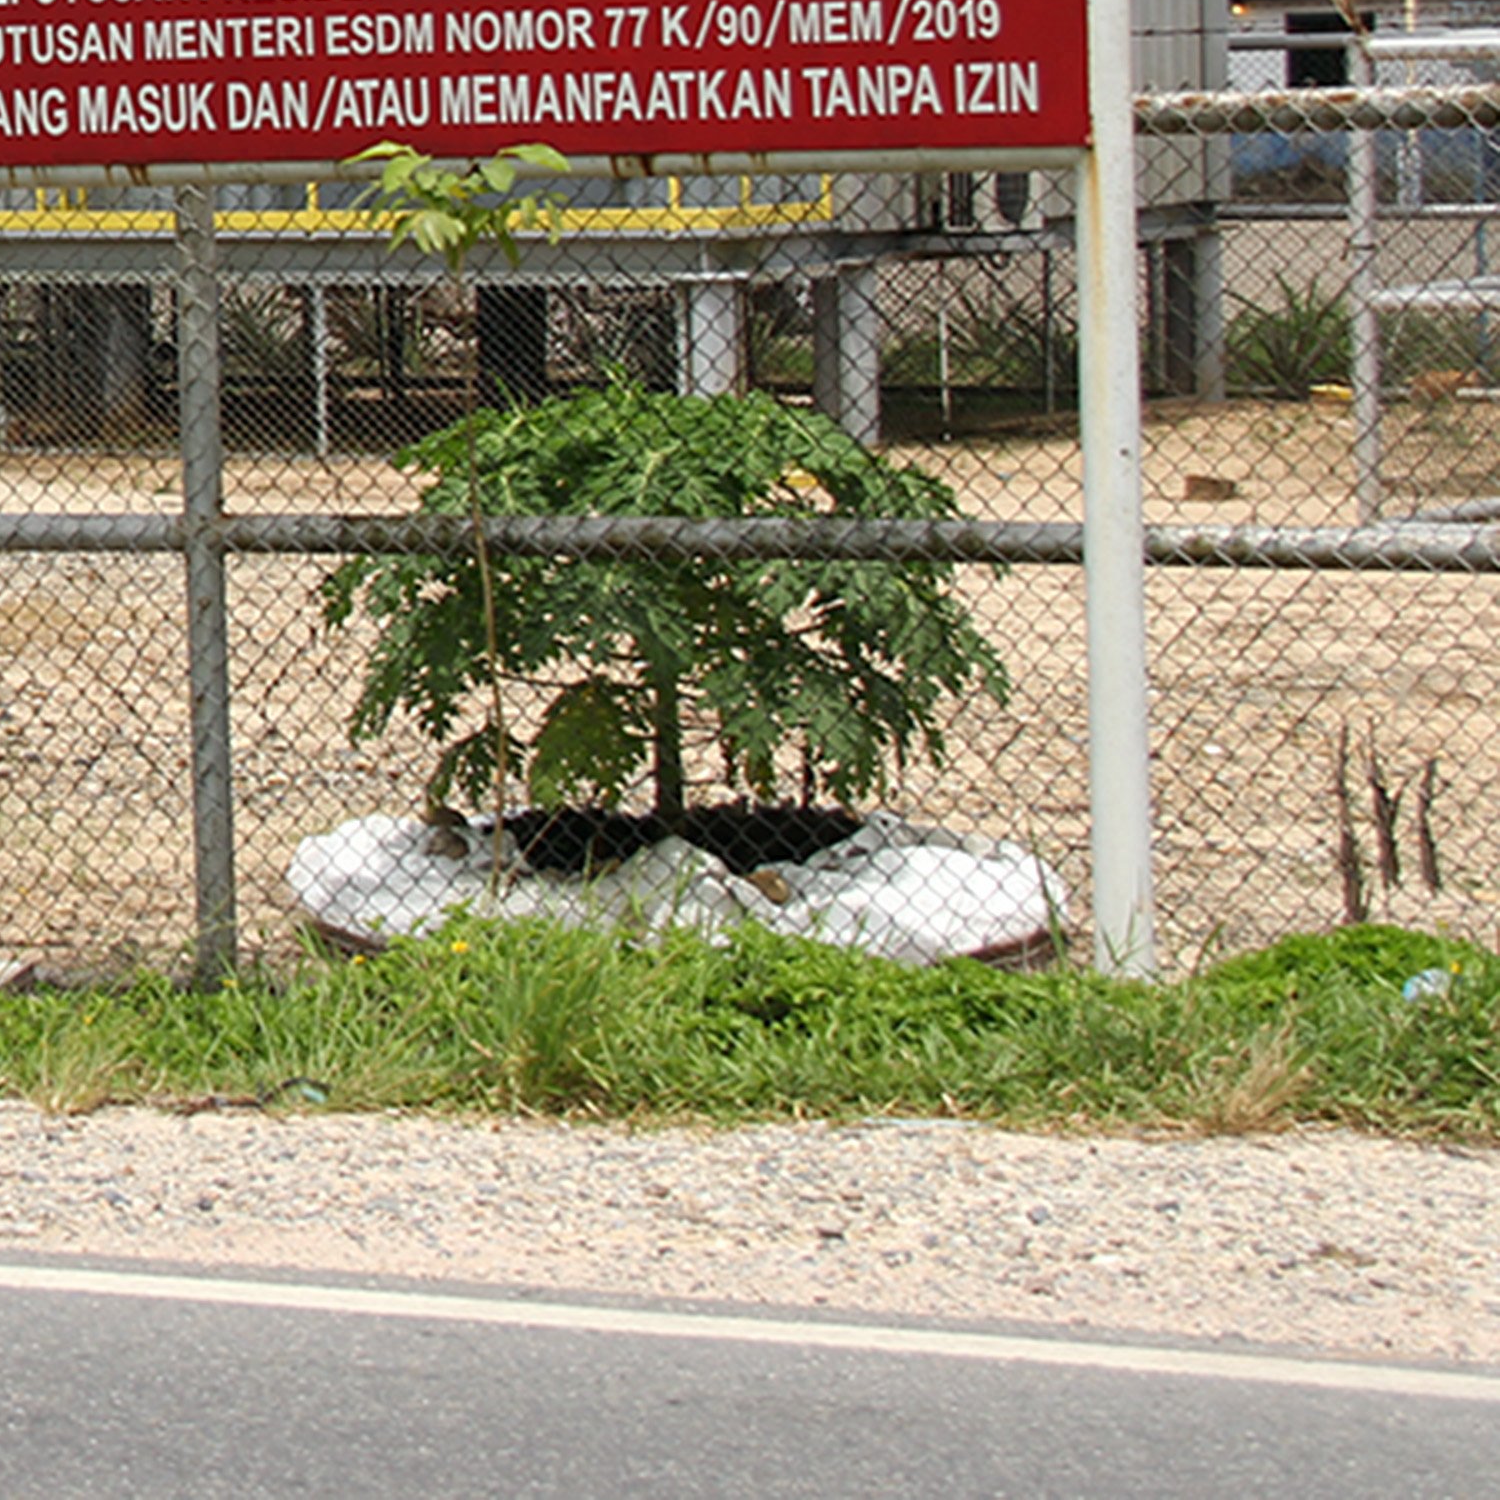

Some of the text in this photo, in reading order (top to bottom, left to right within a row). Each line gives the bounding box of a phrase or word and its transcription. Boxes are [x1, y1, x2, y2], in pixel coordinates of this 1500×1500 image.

[143, 15, 316, 62] MENTERI
[324, 11, 435, 57] ESDM
[444, 6, 597, 54] NOMOR
[603, 5, 651, 49] 77
[77, 81, 218, 134] MASUK
[226, 75, 431, 133] DAN/ATAU
[439, 67, 793, 126] MEMANFAATKAN
[801, 63, 944, 119] TANPA
[953, 60, 1040, 115] IZIN
